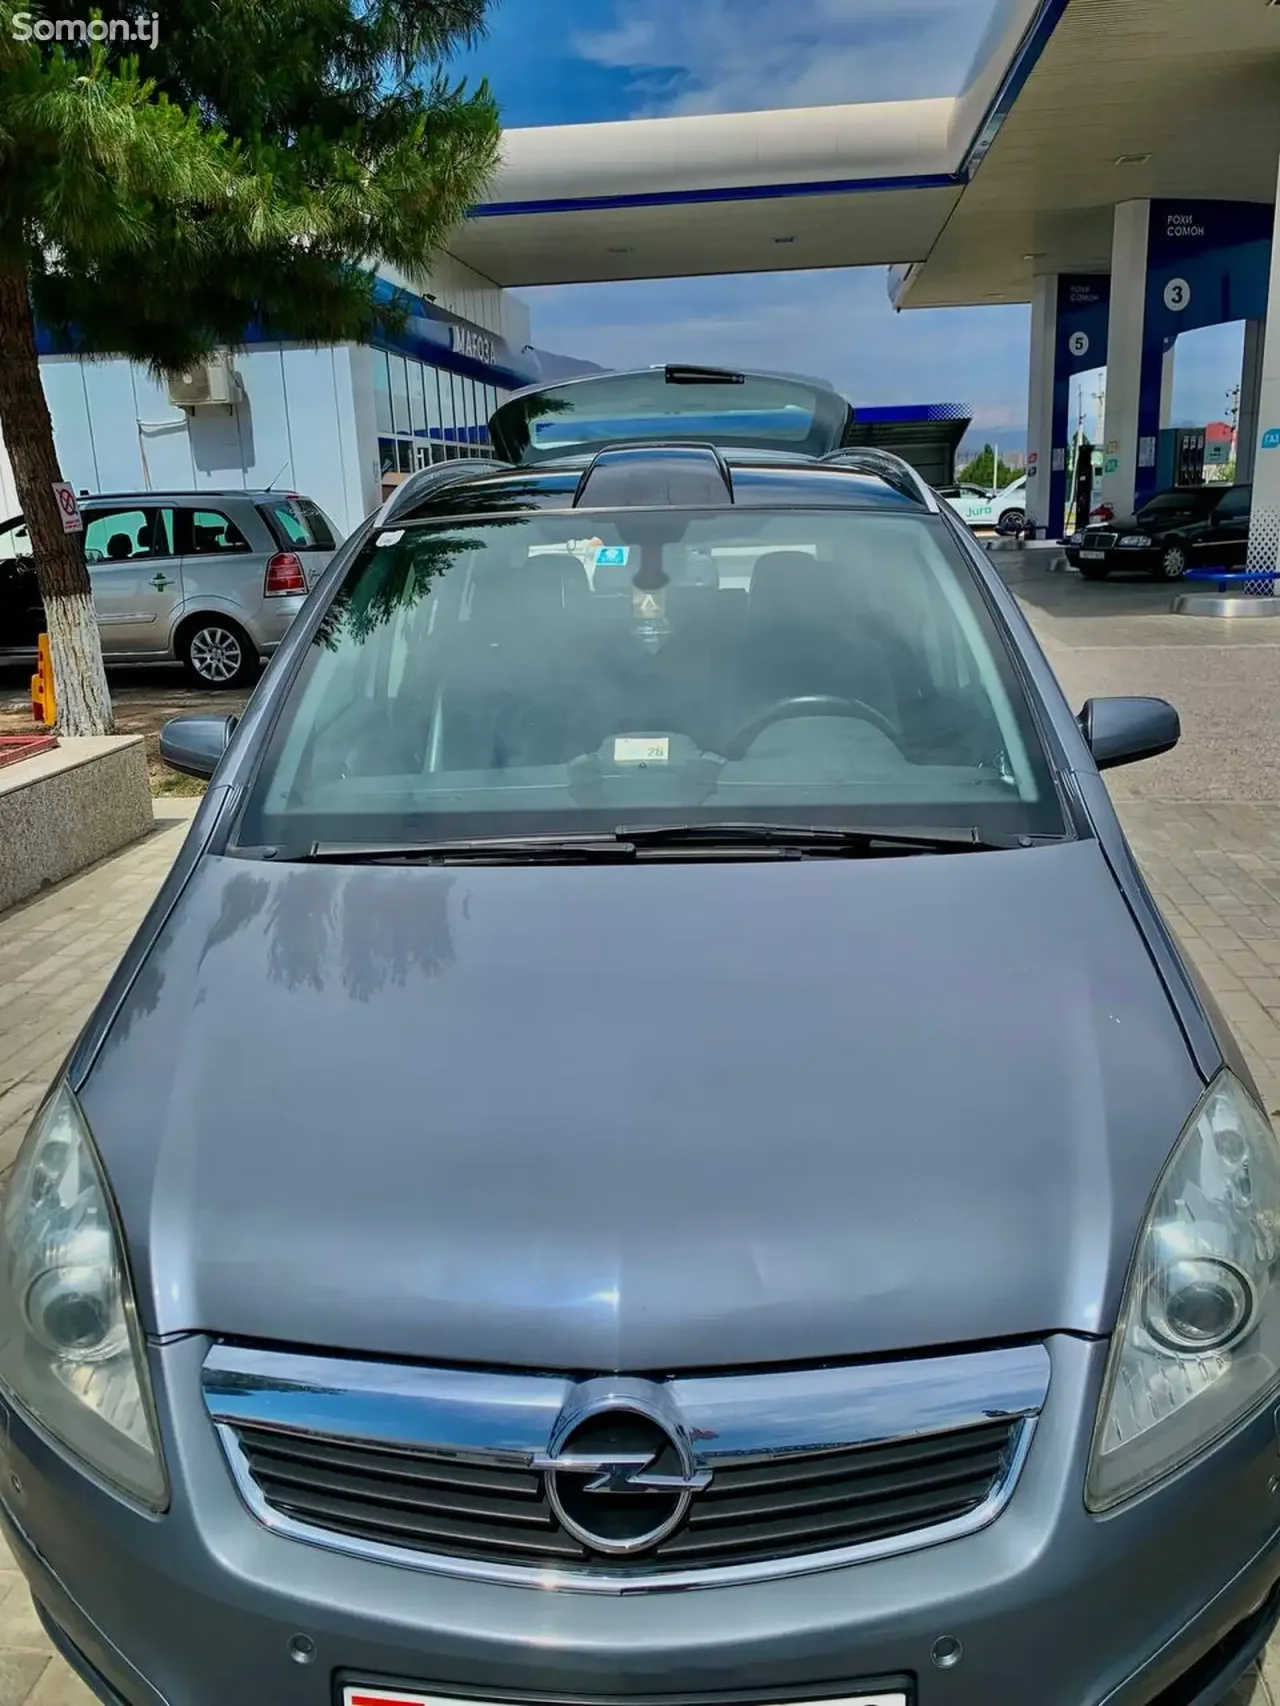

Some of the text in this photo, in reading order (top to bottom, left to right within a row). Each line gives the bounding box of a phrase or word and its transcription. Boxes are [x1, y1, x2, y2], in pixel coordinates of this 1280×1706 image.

[1167, 215, 1193, 225] РОХИ
[1167, 226, 1205, 237] СОМОН
[1171, 286, 1184, 304] 3
[1075, 337, 1083, 350] 5
